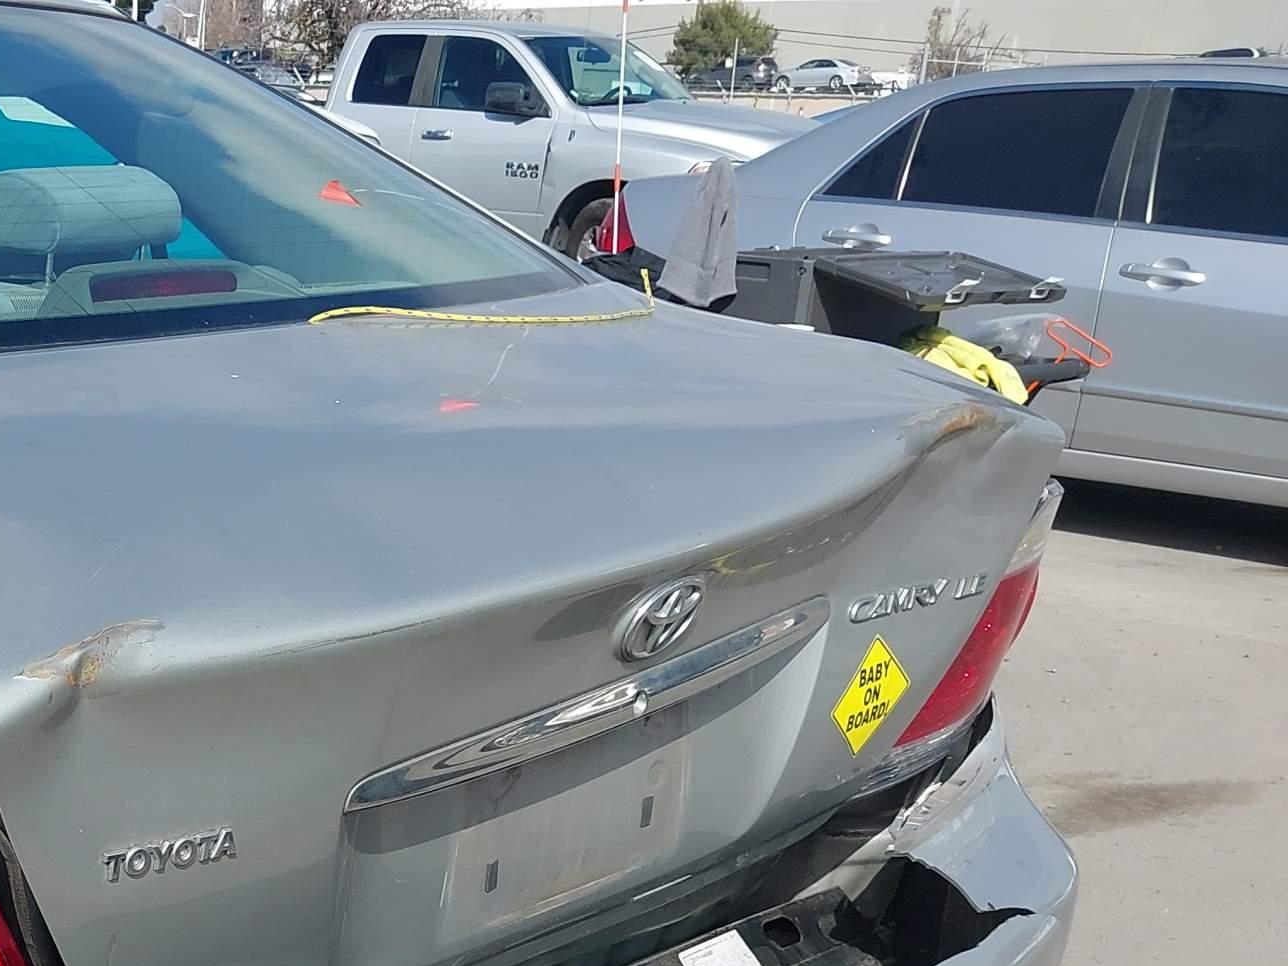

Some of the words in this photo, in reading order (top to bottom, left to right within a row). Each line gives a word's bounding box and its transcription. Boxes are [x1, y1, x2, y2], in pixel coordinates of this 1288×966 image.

[505, 161, 539, 171] RAM
[505, 169, 539, 179] 1500
[848, 576, 949, 624] CAMRY
[953, 571, 987, 600] LE
[858, 658, 892, 688] BABY
[863, 683, 881, 706] ON
[845, 700, 890, 733] BOARD!
[102, 826, 238, 884] TOYOTA
